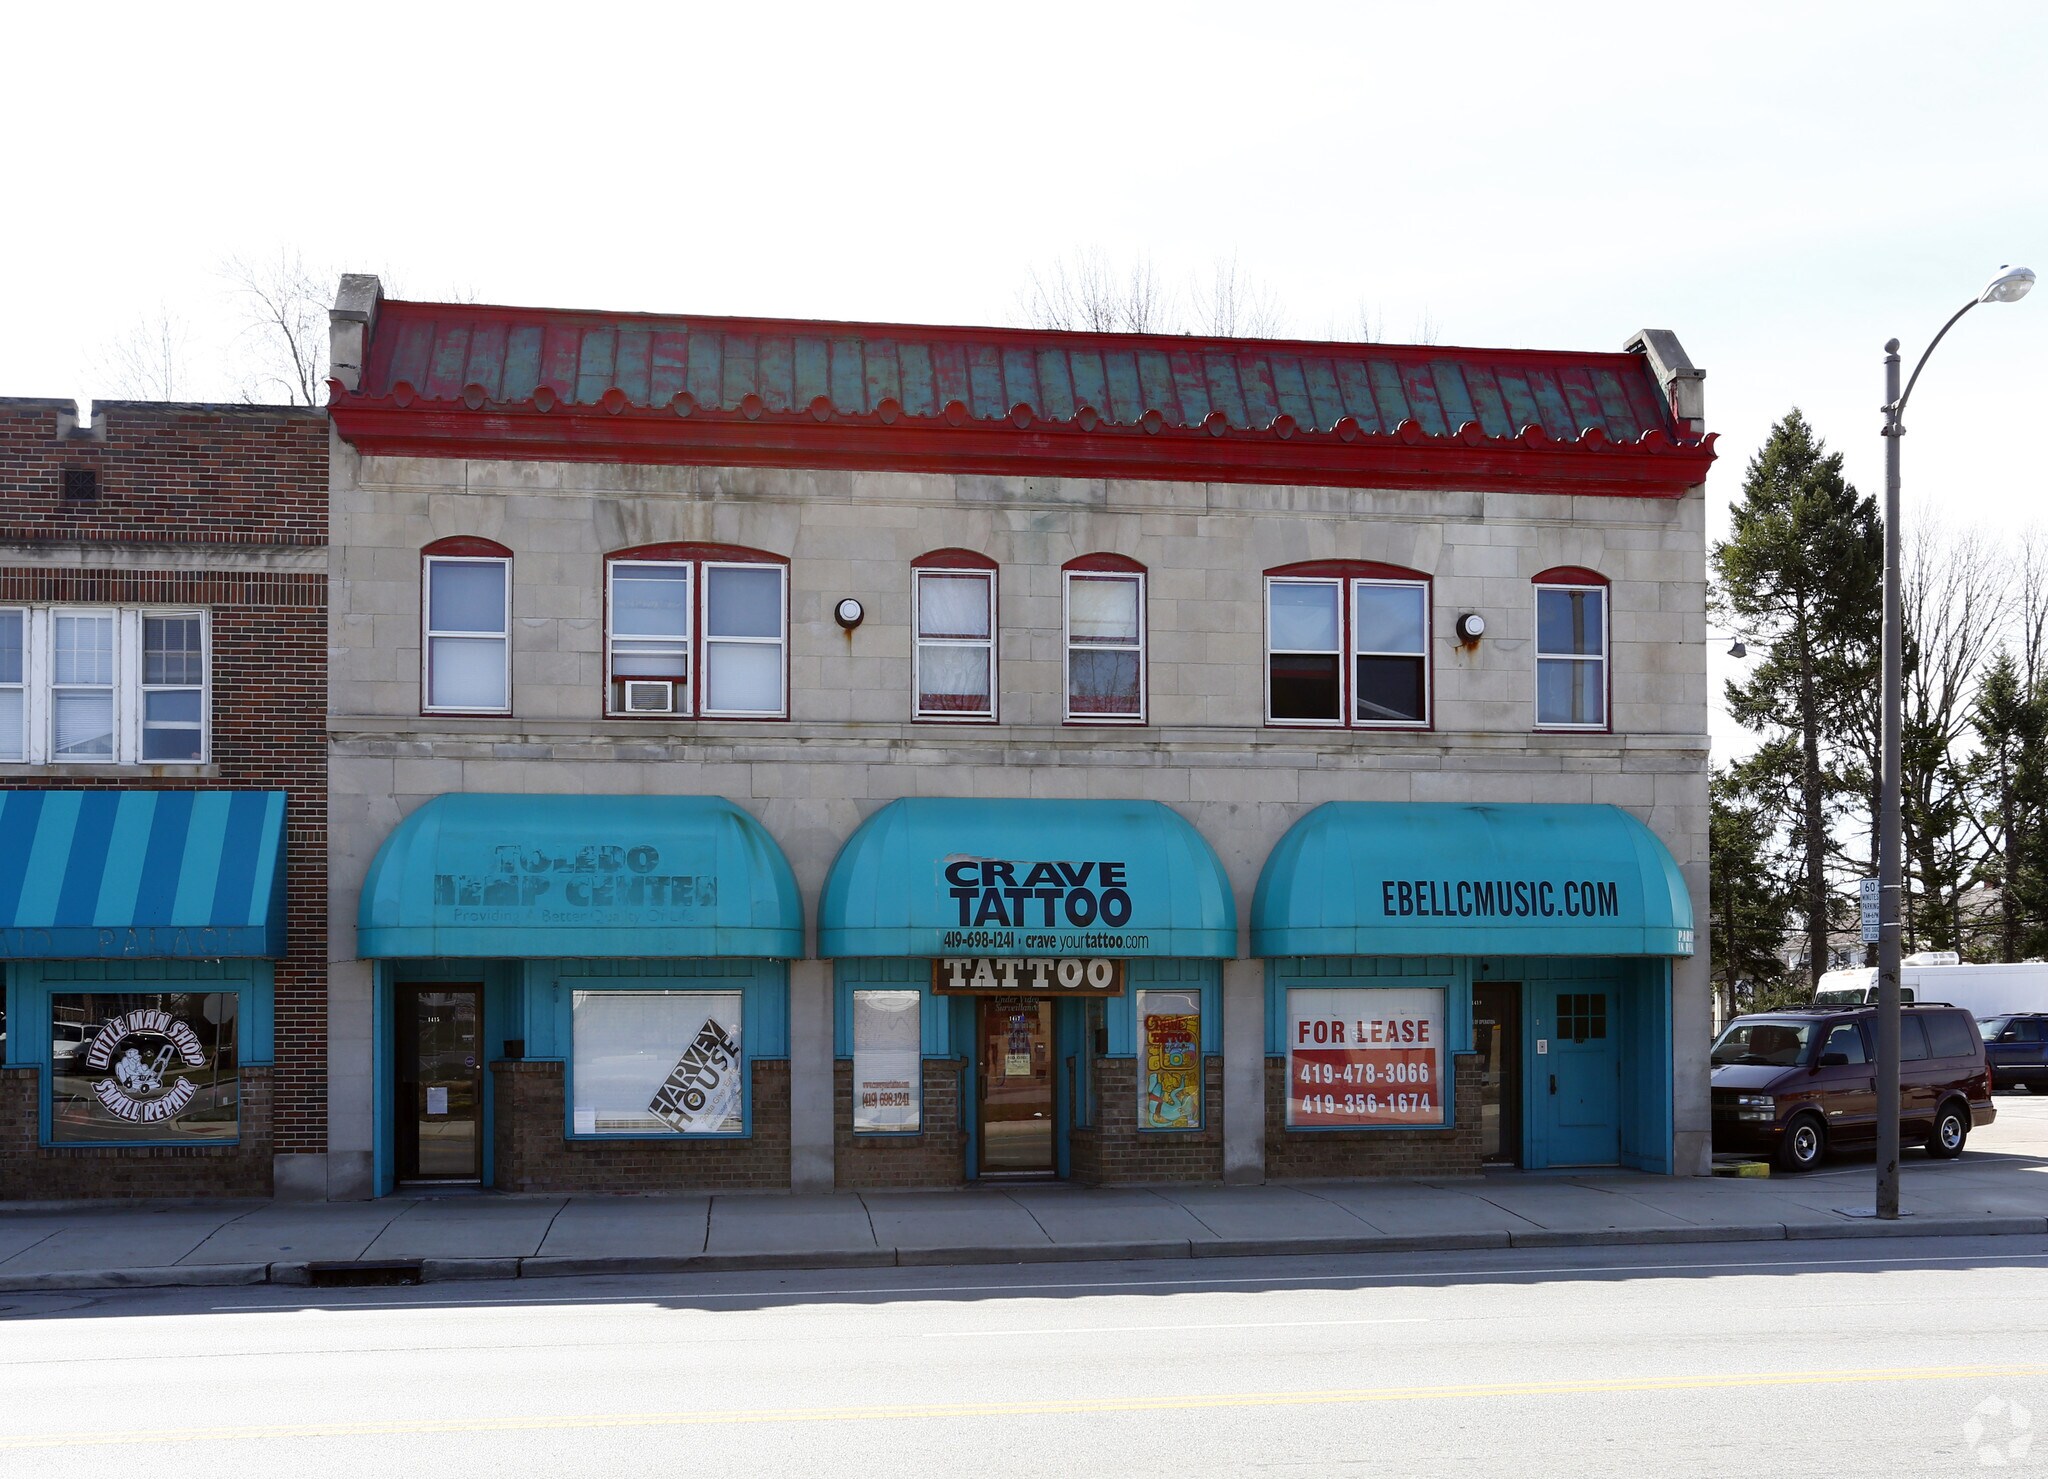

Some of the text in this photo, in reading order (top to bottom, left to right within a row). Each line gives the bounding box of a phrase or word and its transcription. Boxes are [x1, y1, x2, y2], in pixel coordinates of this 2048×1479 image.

[944, 861, 1127, 887] CRAVE
[1865, 882, 1876, 892] 60
[949, 887, 1132, 928] TATTOO
[1381, 880, 1619, 917] EBELLCMUSIC.COM
[944, 931, 1014, 948] 419-698-1241
[944, 958, 1113, 988] TATTOO
[88, 1010, 204, 1068] LITTLE MAN SHOP
[1299, 1020, 1429, 1043] FOR LEASE
[648, 1020, 721, 1121] HARVEY
[666, 1033, 740, 1133] HOUSE
[1301, 1063, 1429, 1084] 419-478-3066
[92, 1078, 197, 1123] SMALL REPAIR
[1302, 1093, 1431, 1114] 419-356-1674
